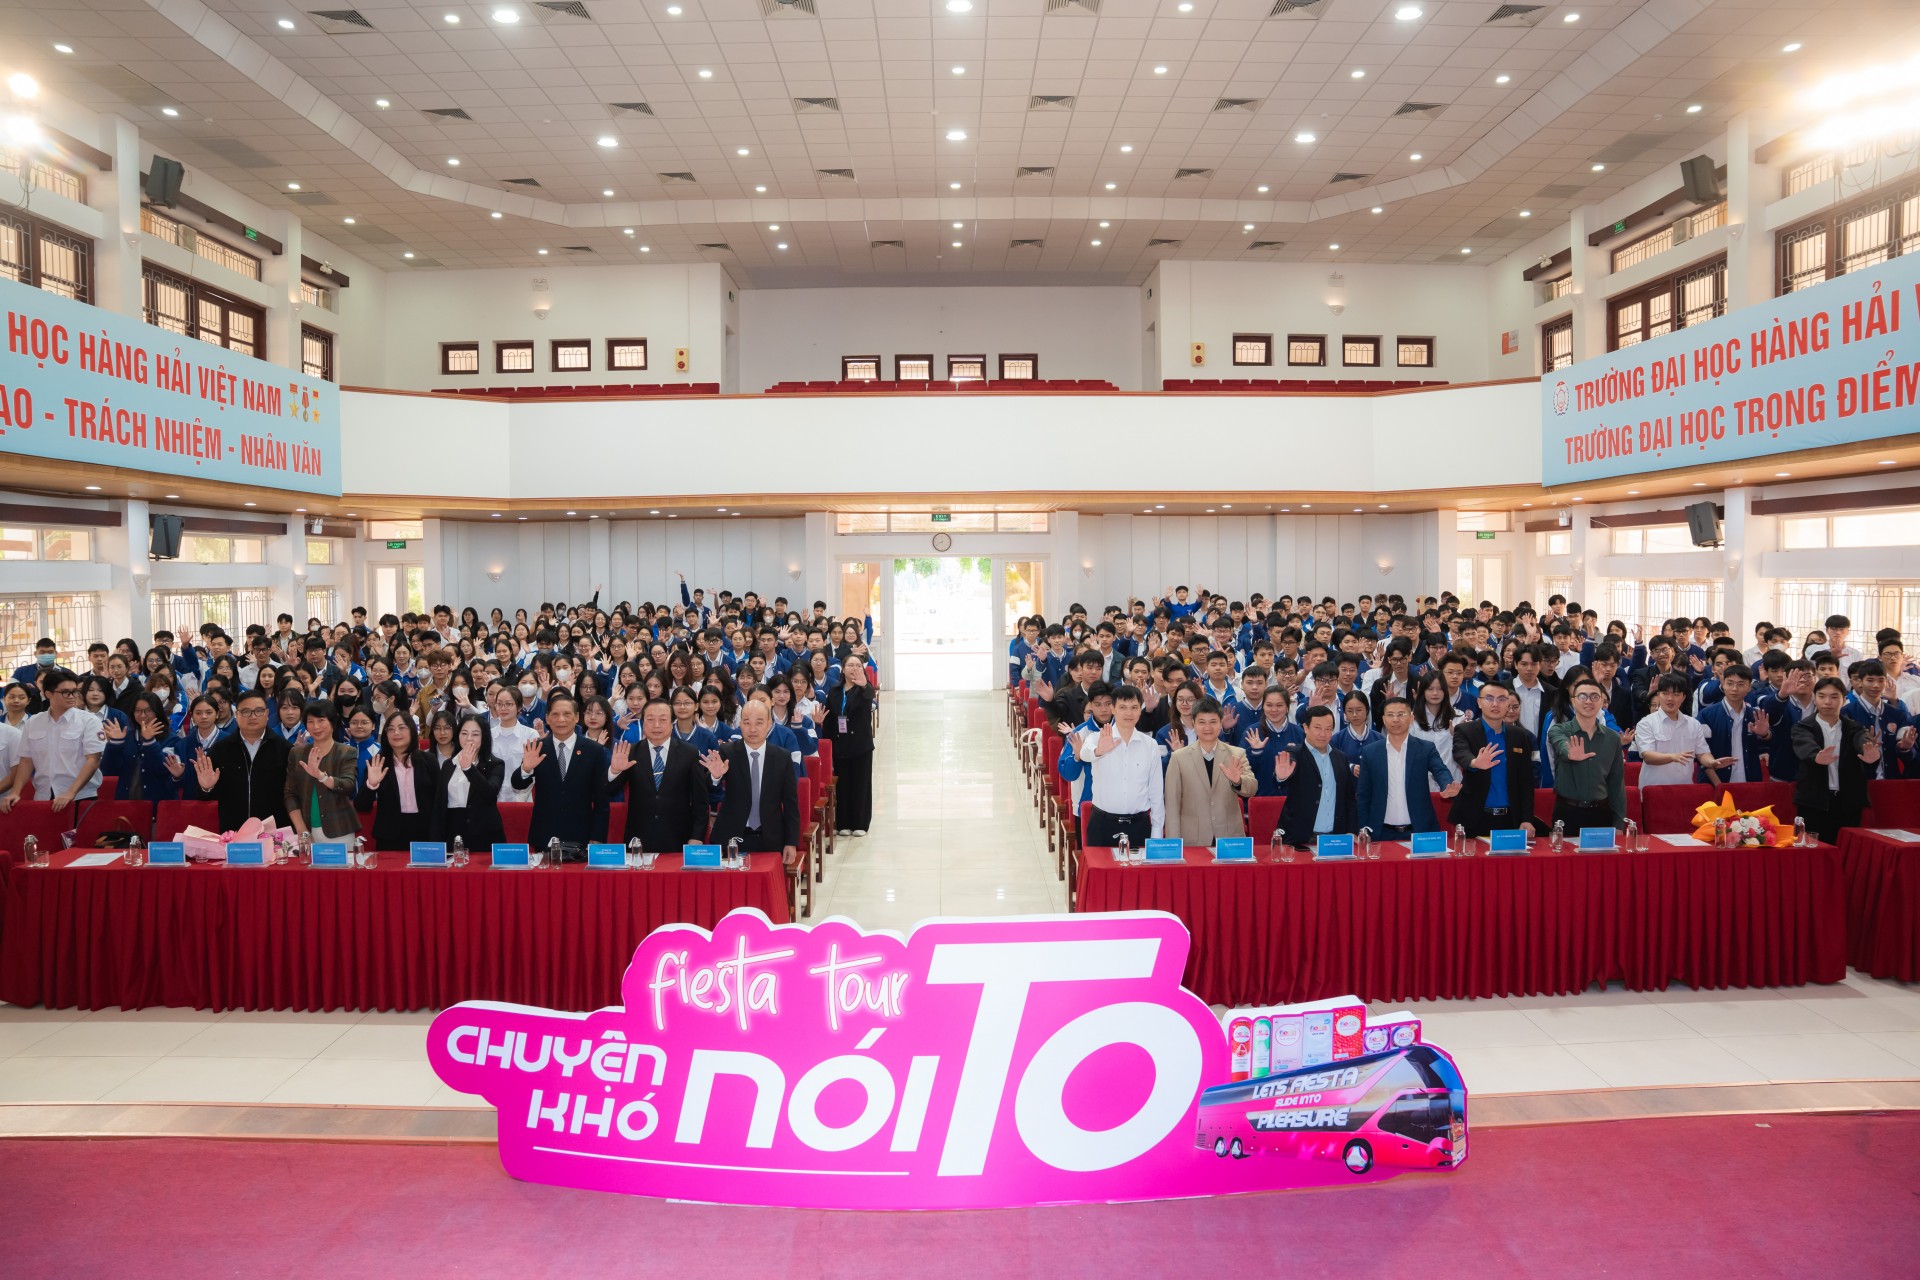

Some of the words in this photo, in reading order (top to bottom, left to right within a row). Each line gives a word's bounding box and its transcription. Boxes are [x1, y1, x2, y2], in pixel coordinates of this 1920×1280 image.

[8, 311, 69, 369] HỌC
[79, 330, 148, 384] HÀNG
[156, 347, 191, 395] HẢI
[198, 364, 237, 411] VIỆT
[243, 379, 281, 417] NAM
[1575, 365, 1645, 412] TRƯỜNG
[1651, 353, 1686, 397] ĐẠI
[1694, 338, 1741, 386] HỌC
[1750, 311, 1830, 369] HÀNG
[1842, 280, 1900, 345] HẢI
[64, 397, 147, 449] TRÁCH
[155, 417, 222, 465] NHIỆM
[241, 434, 287, 471] NHÂN
[292, 440, 321, 476] VĂN
[1565, 422, 1633, 465] TRƯỜNG
[1639, 415, 1673, 457] ĐẠI
[1680, 405, 1725, 450] HỌC
[1733, 383, 1827, 439] TRỌNG
[1837, 349, 1920, 418] ĐIỂM
[649, 935, 795, 1031] fiesta
[809, 943, 909, 1031] tour
[526, 1090, 659, 1141] KHÓ
[926, 939, 1203, 1177] TO
[1252, 1079, 1289, 1099] LETS
[1290, 1067, 1359, 1094] FIESTA
[1274, 1096, 1299, 1107] SLIDE
[1257, 1107, 1350, 1129] PLEASURE
